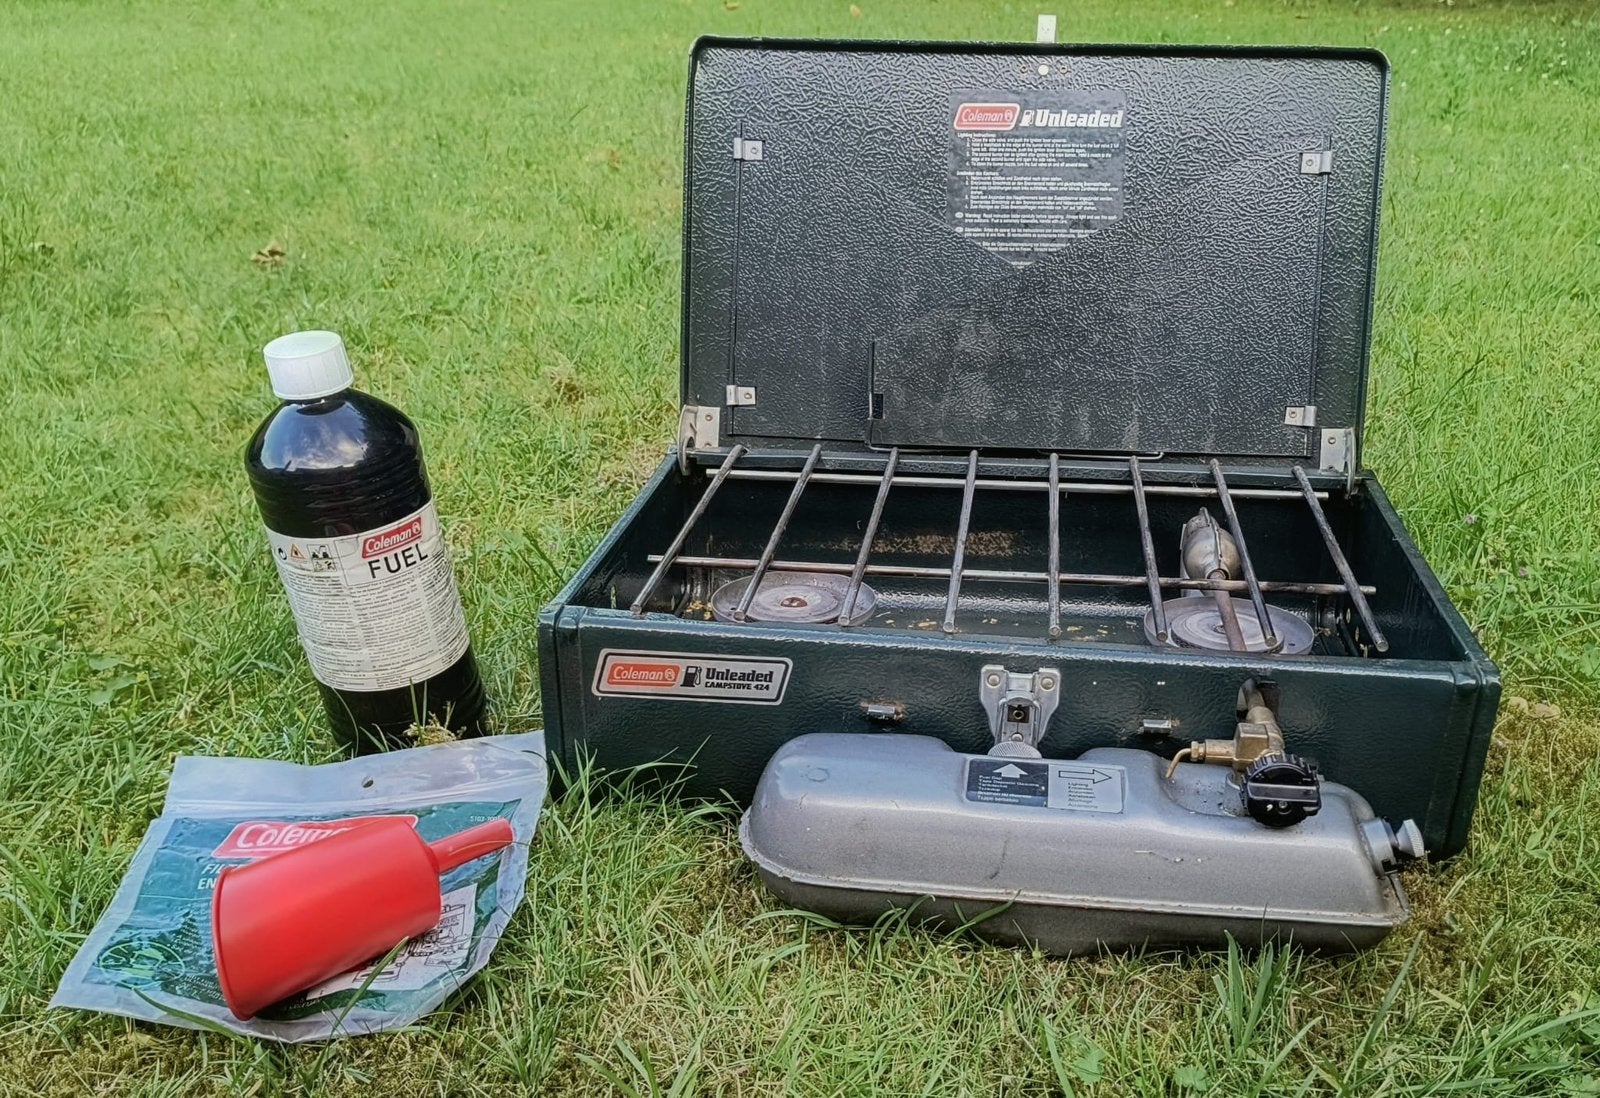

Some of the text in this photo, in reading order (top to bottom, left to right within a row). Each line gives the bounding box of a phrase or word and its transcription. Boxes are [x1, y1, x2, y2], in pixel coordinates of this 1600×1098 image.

[961, 108, 1124, 128] Coleman Unleaded
[365, 529, 412, 553] Coleman
[368, 543, 428, 579] FUEL
[613, 665, 774, 683] Coleman Unleaded
[704, 681, 770, 691] CAMPSTOVE 424
[237, 823, 351, 848] Colem
